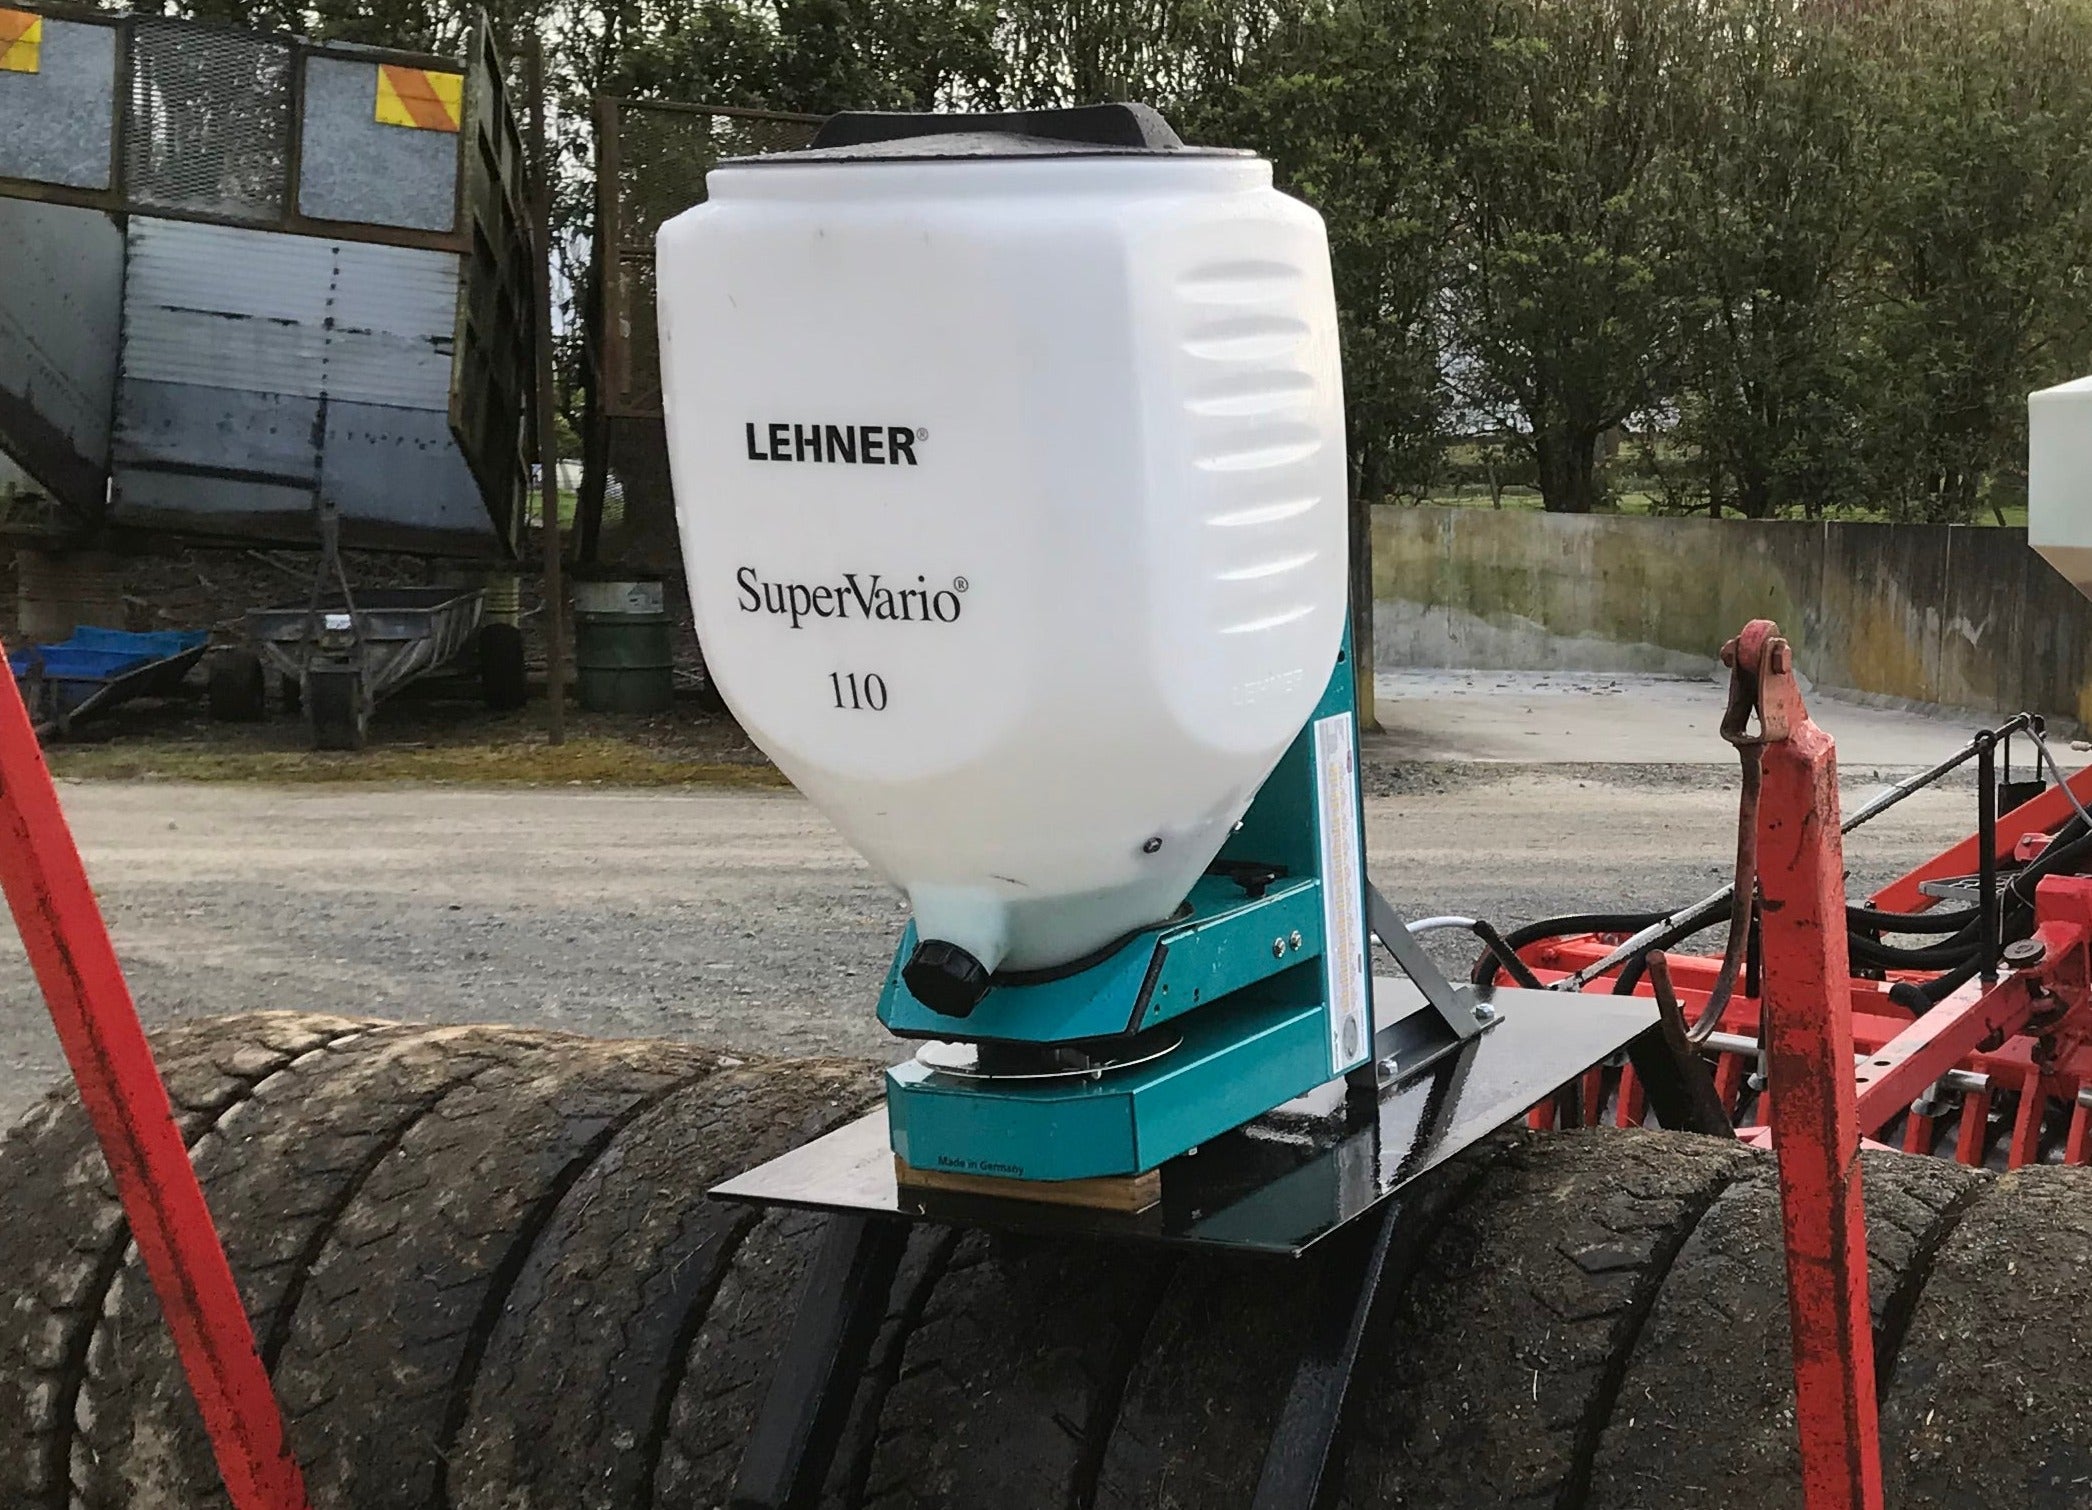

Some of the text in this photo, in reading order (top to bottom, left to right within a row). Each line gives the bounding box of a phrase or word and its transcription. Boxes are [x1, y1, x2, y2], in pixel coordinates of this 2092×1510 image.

[828, 671, 888, 712] 110
[937, 1155, 1024, 1177] Made in Germany
